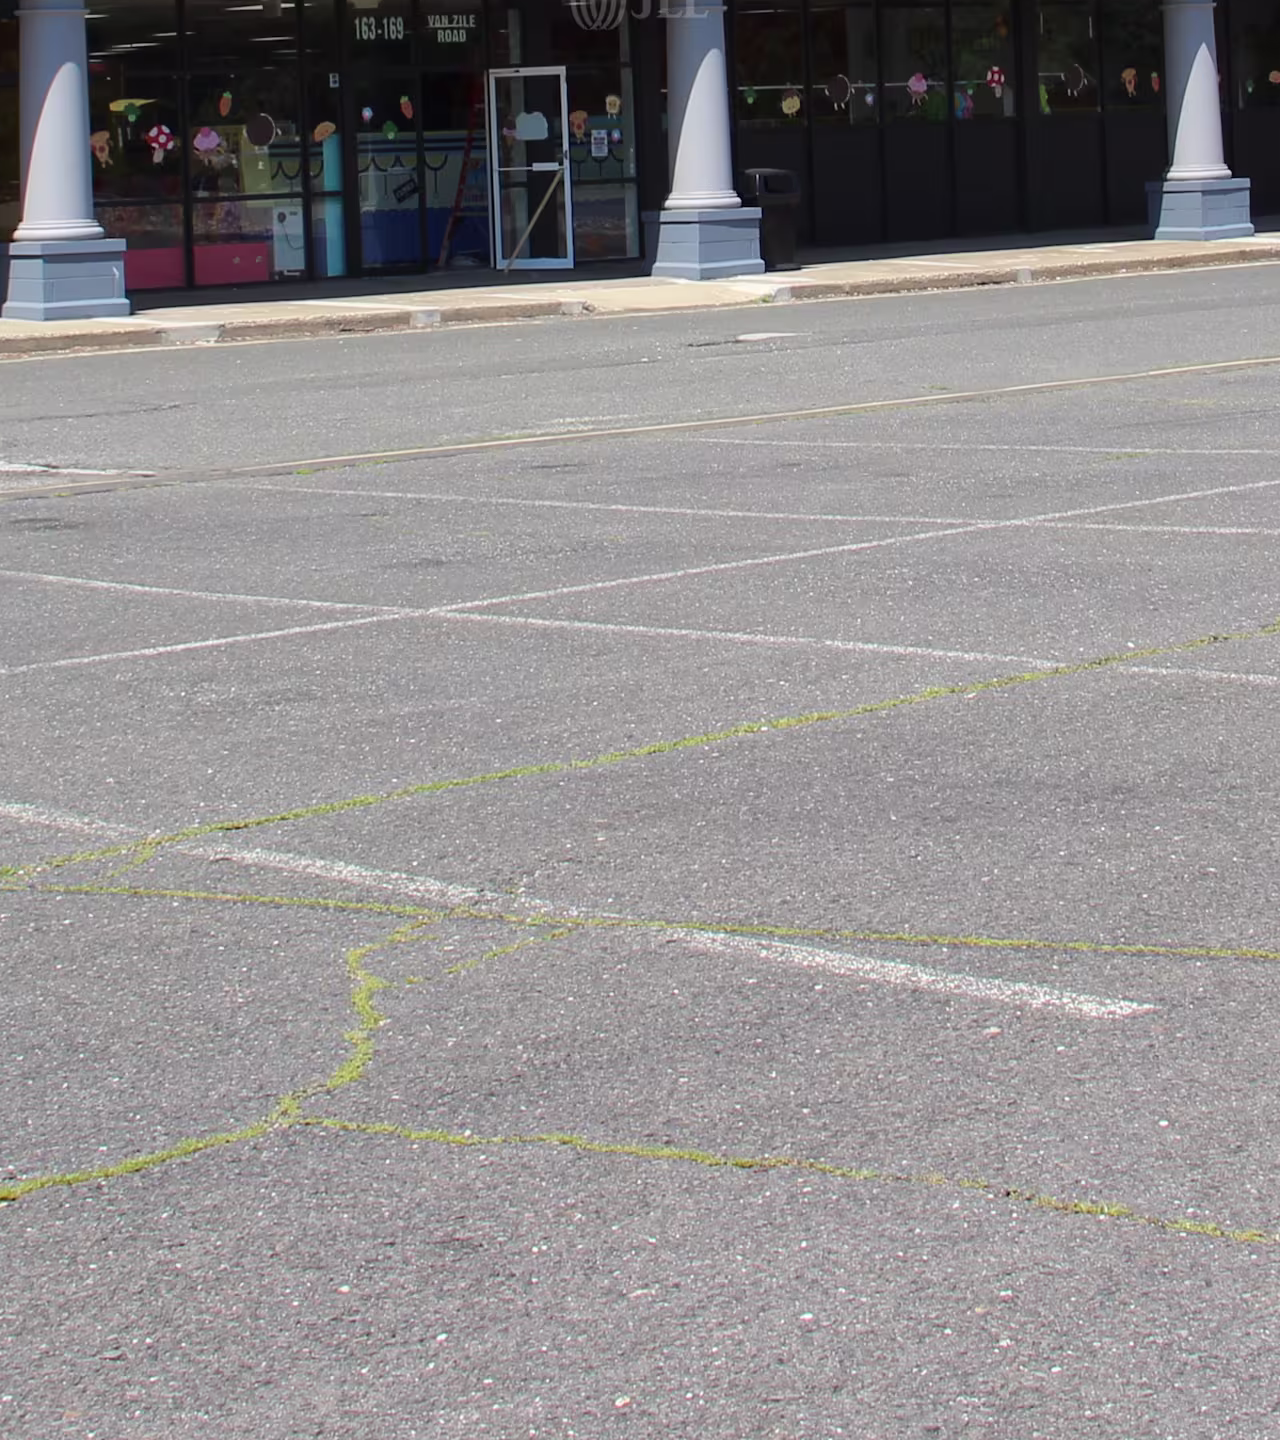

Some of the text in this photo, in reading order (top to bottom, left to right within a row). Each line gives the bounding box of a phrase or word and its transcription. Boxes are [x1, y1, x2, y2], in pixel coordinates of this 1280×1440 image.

[354, 16, 404, 40] 163-169
[427, 14, 476, 28] VAN ZILE
[437, 29, 467, 43] ROAD
